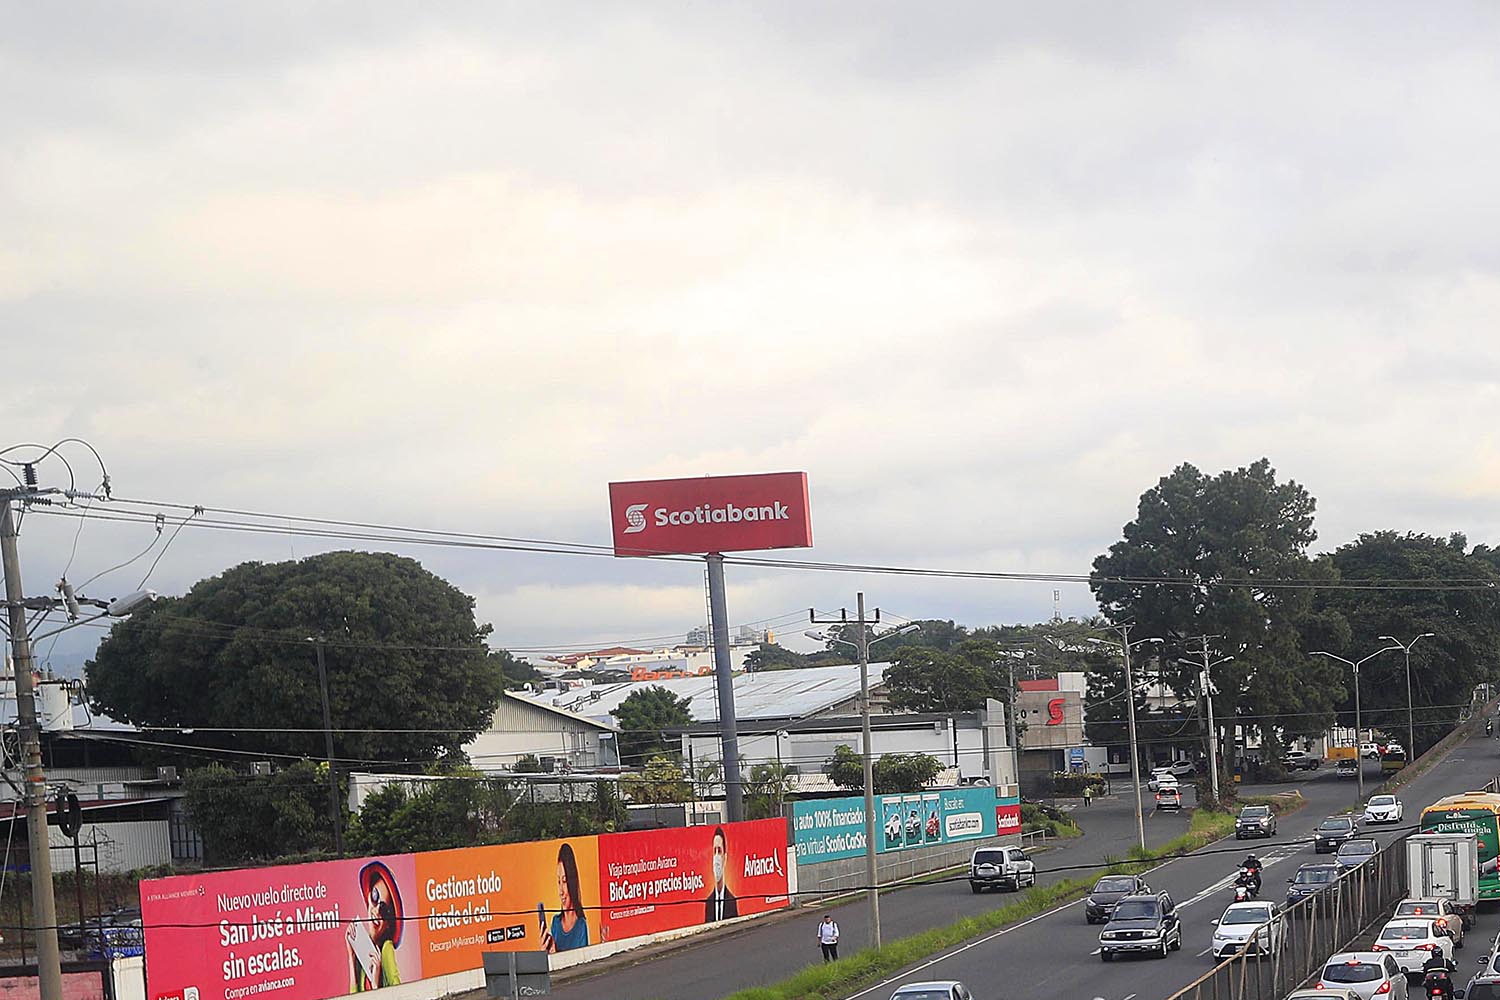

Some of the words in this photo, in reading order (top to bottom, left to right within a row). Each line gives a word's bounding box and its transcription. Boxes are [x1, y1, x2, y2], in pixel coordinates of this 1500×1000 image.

[654, 501, 789, 527] Scotiabank
[799, 813, 813, 830] auto
[815, 810, 832, 828] 100%
[833, 807, 863, 827] financiado
[807, 835, 825, 854] virtual
[826, 834, 845, 853] Scotia
[608, 862, 622, 879] Viaja
[622, 859, 647, 876] tranquilo
[657, 856, 677, 869] Avianca
[743, 852, 774, 878] Avianca
[217, 892, 250, 912] Nuevo
[251, 886, 279, 907] vuelo
[280, 882, 312, 904] directo
[313, 879, 327, 899] de
[426, 875, 476, 902] Gestiona
[476, 870, 501, 893] todo
[609, 880, 641, 902] BioCare
[641, 881, 648, 900] y
[648, 880, 654, 895] a
[654, 872, 682, 898] precios
[682, 870, 704, 893] bajos.
[219, 920, 249, 946] San
[251, 910, 283, 942] José
[286, 917, 294, 935] a
[296, 903, 340, 933] Miami
[428, 904, 461, 931] desde
[462, 901, 472, 925] el
[223, 952, 247, 980] sin
[247, 942, 303, 977] escalas.
[224, 985, 249, 1000] Compra
[258, 975, 294, 993] avianca.com
